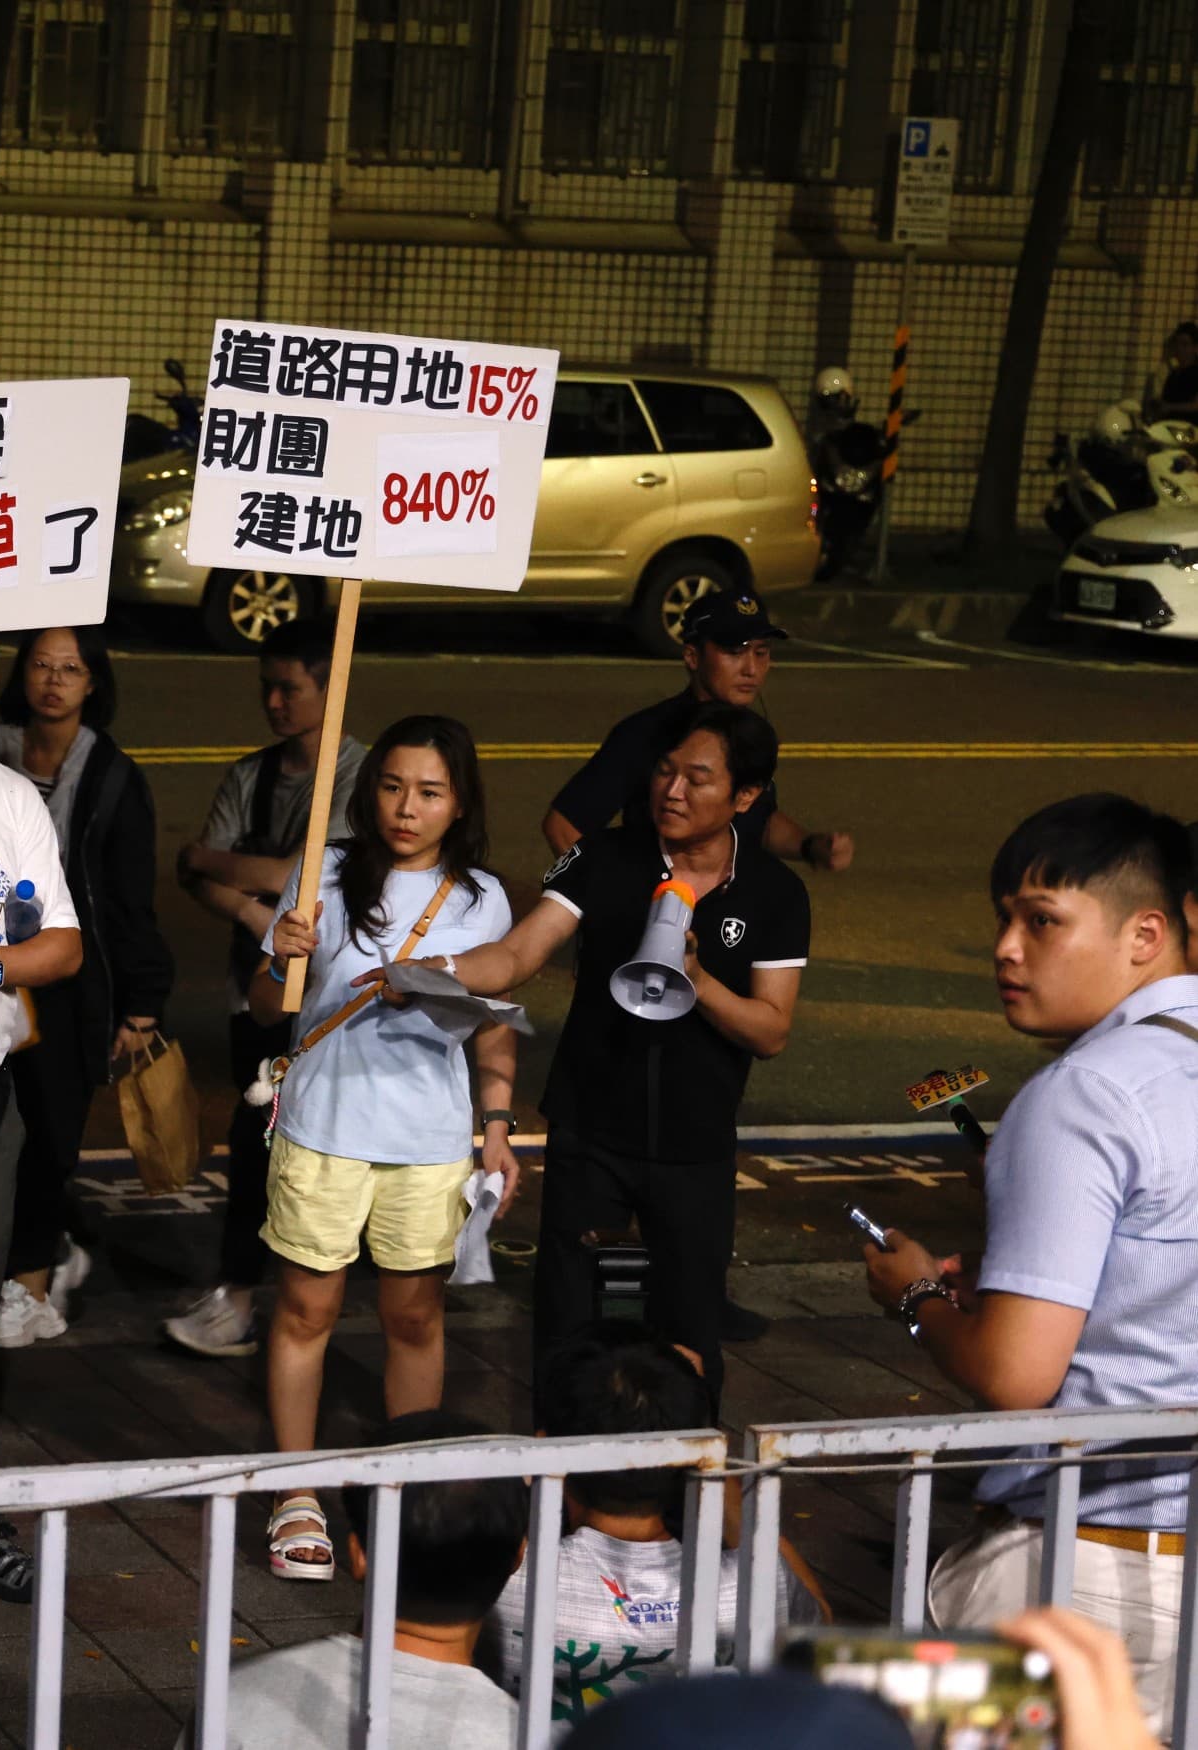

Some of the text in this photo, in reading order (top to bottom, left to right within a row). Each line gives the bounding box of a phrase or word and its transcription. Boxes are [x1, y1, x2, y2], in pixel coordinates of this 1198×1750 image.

[201, 407, 329, 479] 財團
[44, 506, 99, 575] 了
[233, 467, 496, 558] 建地 840%
[920, 1076, 976, 1105] PLUS
